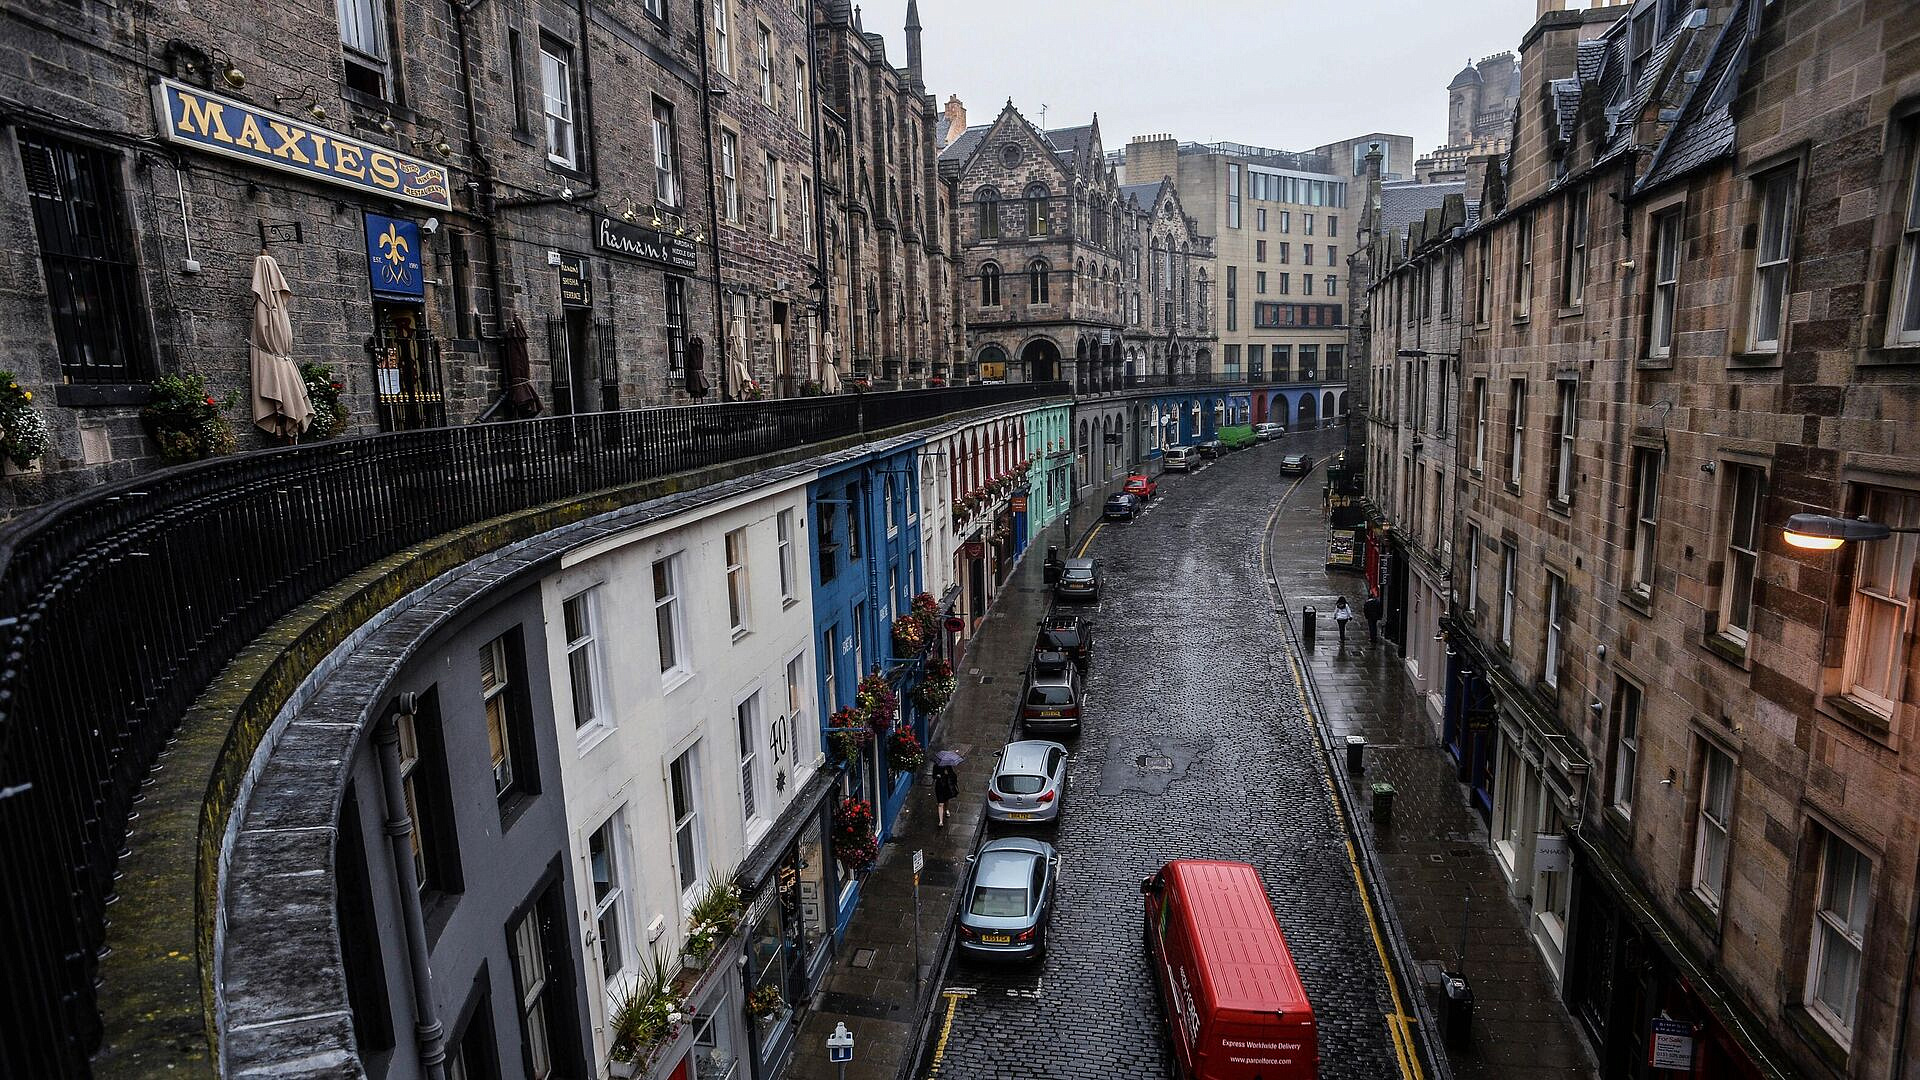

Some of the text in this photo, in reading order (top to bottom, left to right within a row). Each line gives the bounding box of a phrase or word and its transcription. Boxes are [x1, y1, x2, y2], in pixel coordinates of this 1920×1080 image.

[178, 92, 400, 189] MAXIES
[769, 714, 786, 766] 40
[1222, 1039, 1246, 1048] Express
[1278, 1042, 1301, 1051] Delivery
[1230, 1056, 1292, 1065] www.parcelforce.com
